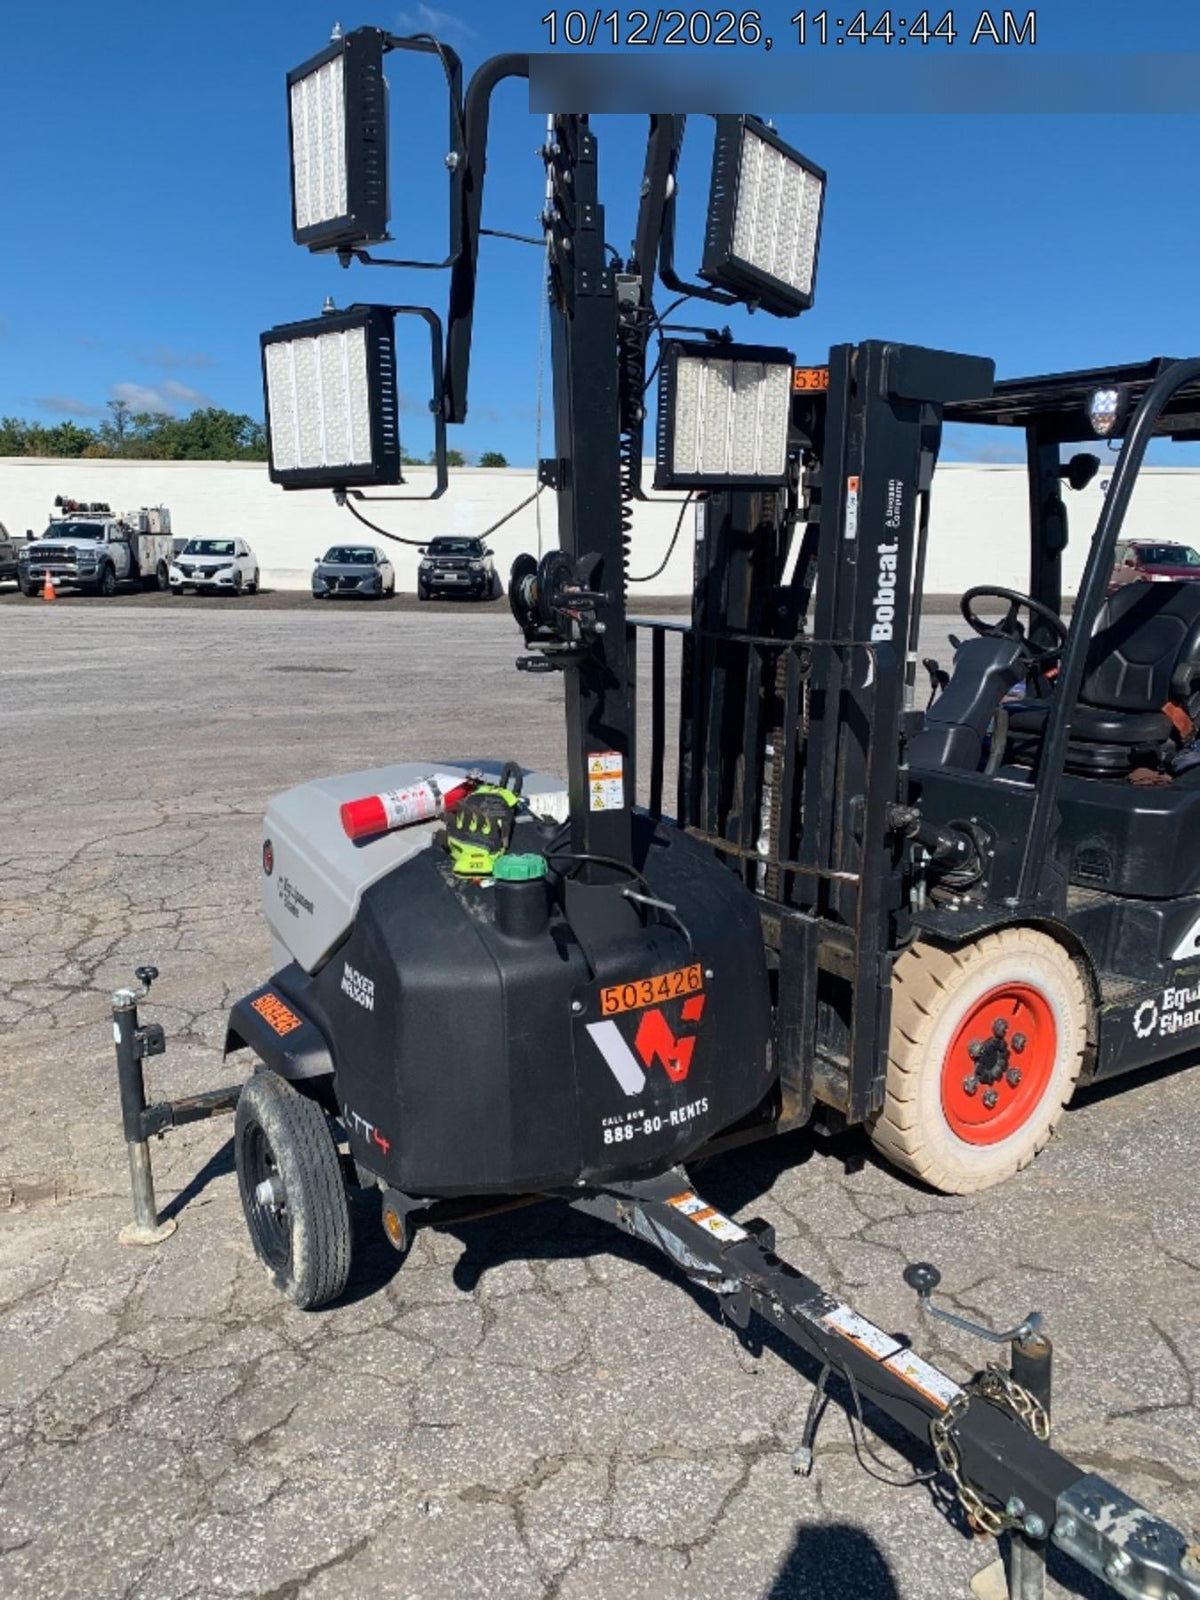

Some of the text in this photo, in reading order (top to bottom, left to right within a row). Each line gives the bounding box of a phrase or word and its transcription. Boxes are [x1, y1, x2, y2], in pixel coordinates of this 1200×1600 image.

[604, 966, 701, 1013] 503426
[602, 1116, 624, 1126] CALL
[603, 1097, 709, 1144] 888-80-RENTS
